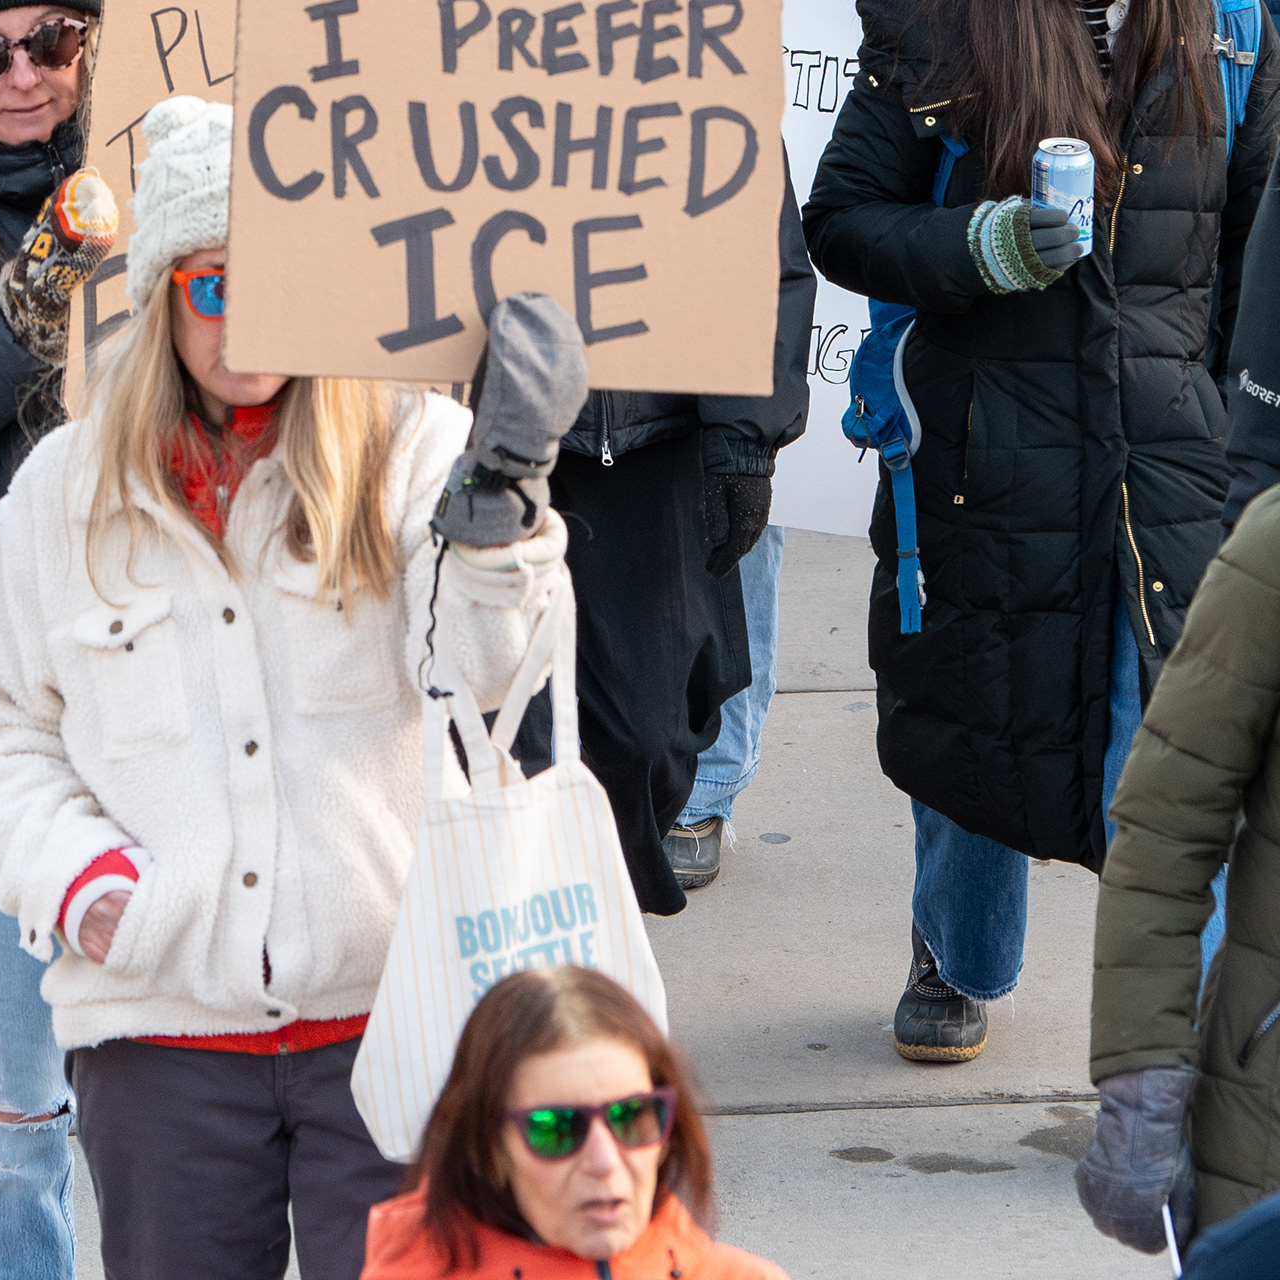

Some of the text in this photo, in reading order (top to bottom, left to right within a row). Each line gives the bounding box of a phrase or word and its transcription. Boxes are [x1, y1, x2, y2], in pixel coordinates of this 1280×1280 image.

[150, 6, 236, 94] PL
[247, 84, 760, 218] CRUSHED
[370, 207, 649, 353] ICE
[455, 882, 599, 960] BONJOUR
